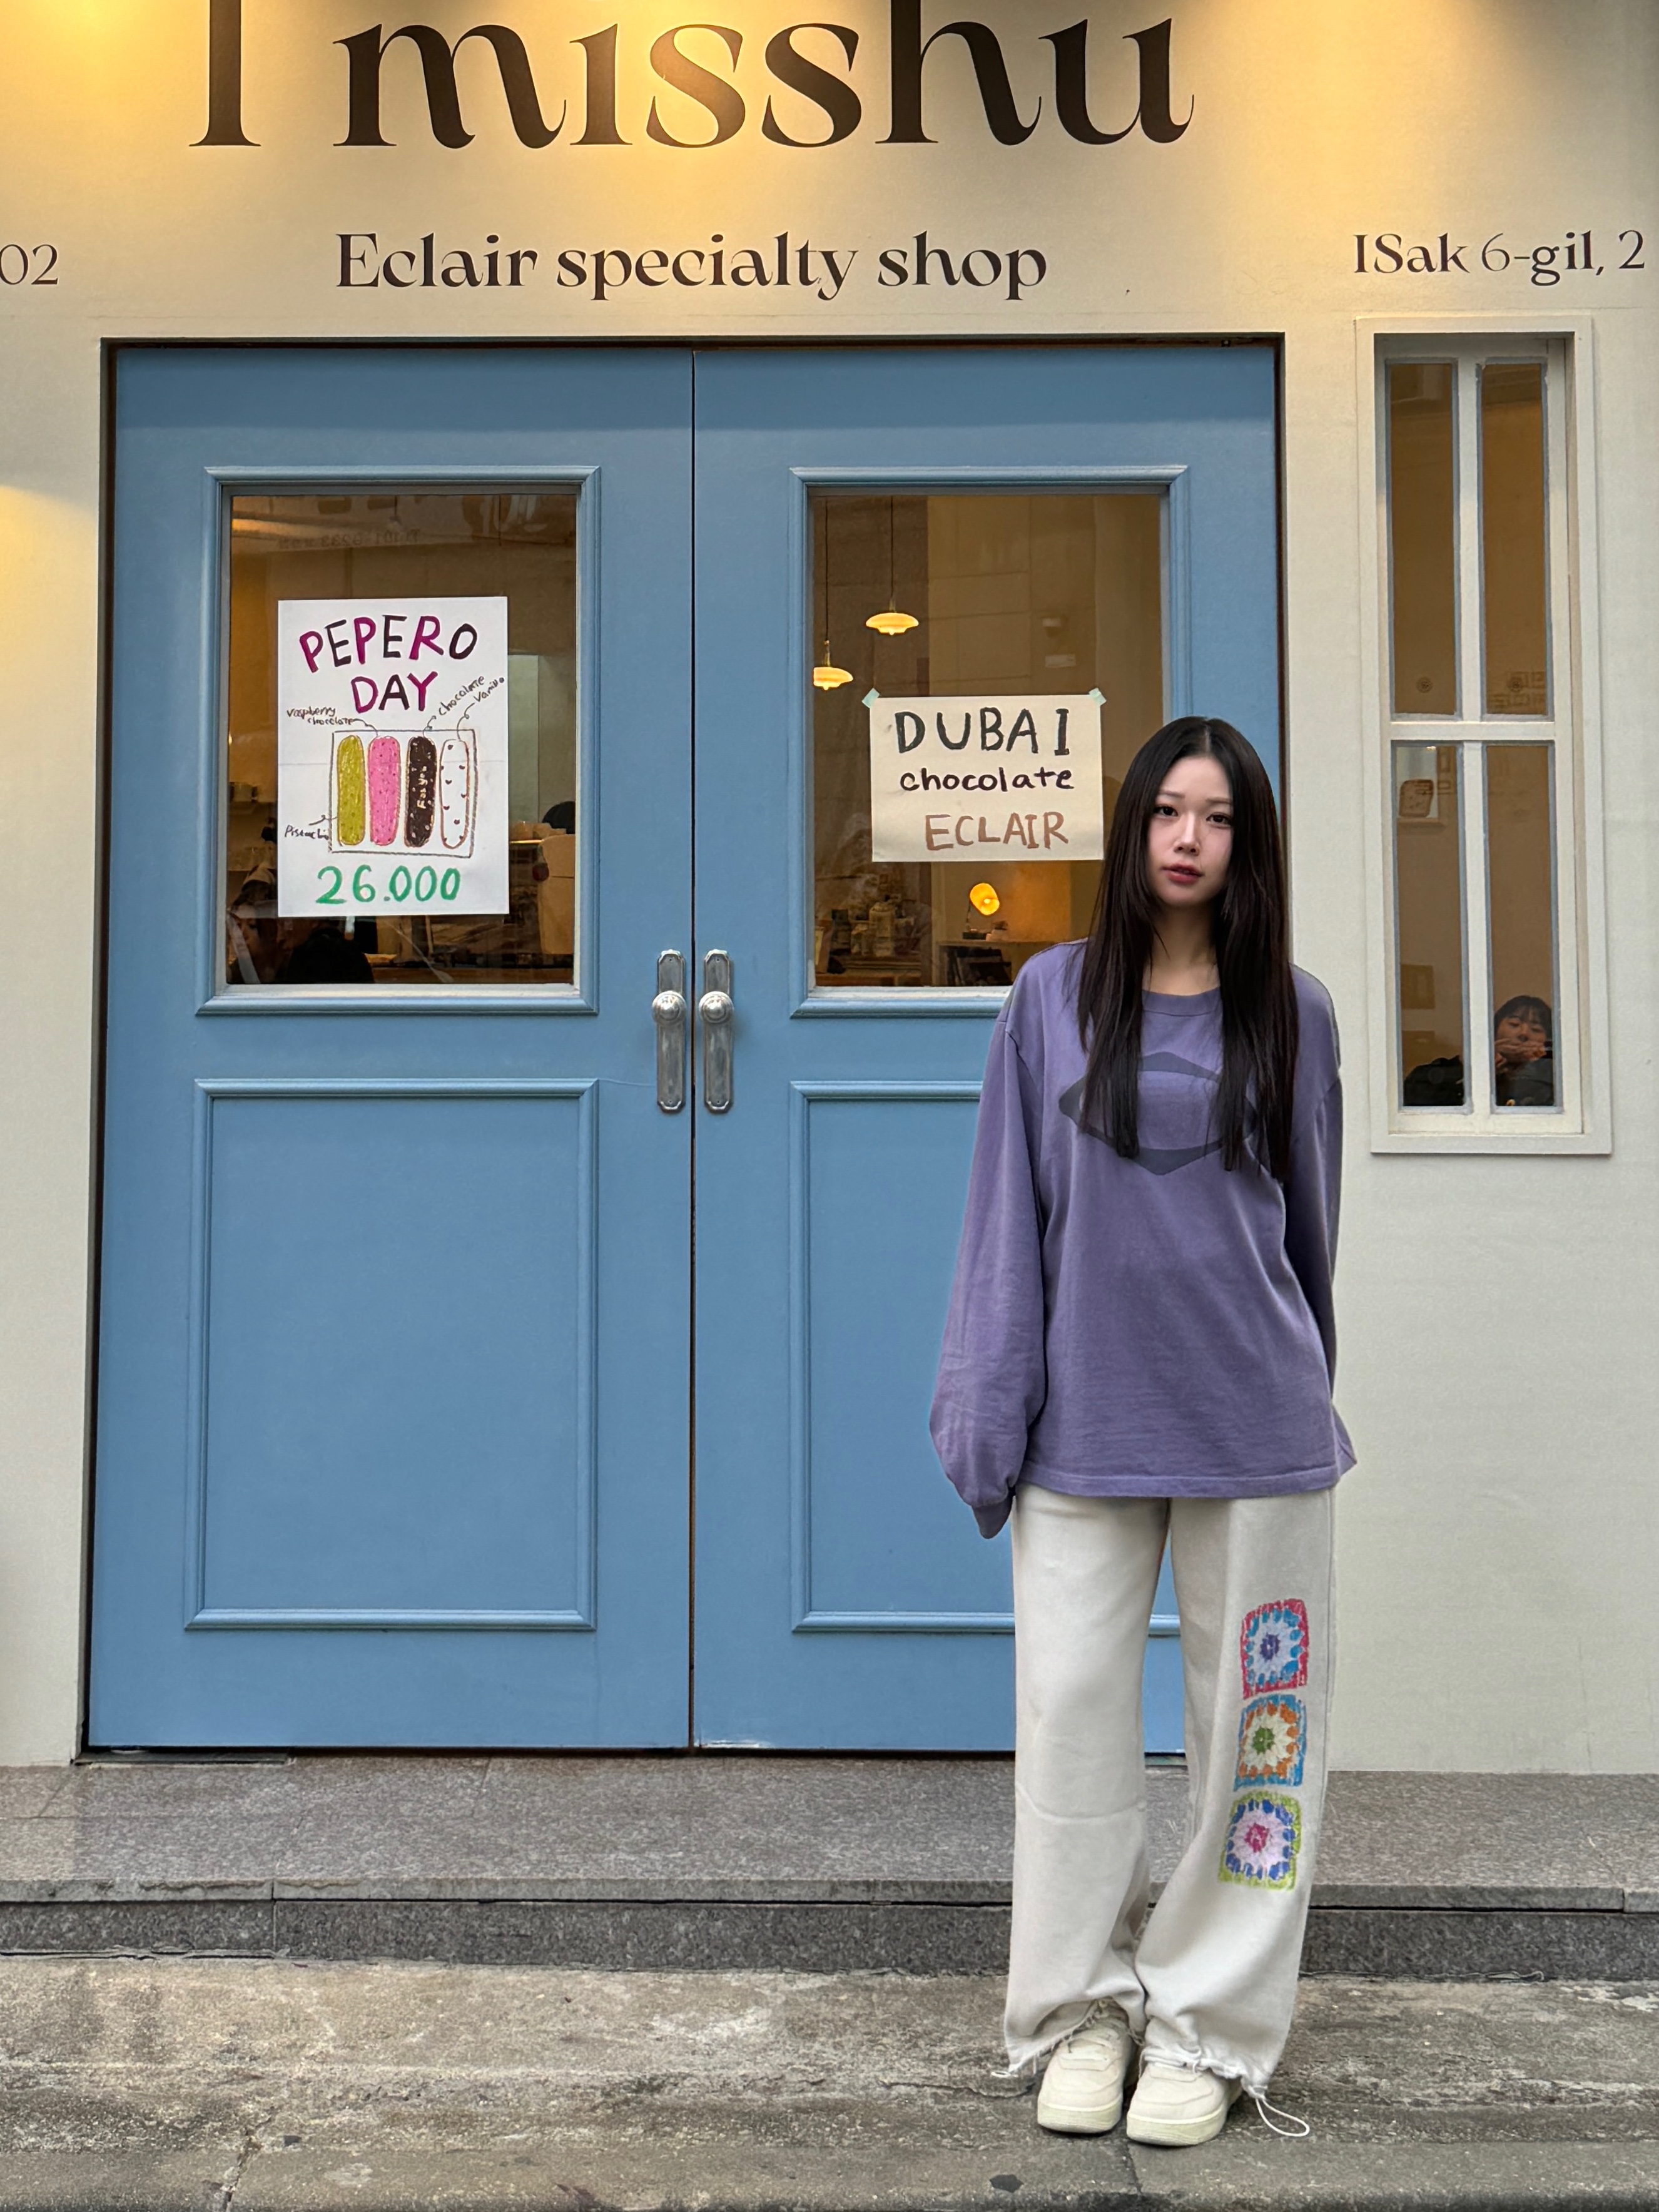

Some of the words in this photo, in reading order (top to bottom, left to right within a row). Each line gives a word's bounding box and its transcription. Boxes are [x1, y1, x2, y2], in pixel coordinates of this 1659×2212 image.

[0, 244, 58, 285] 02
[336, 232, 538, 288] Eclair
[557, 231, 858, 301] specialty
[878, 230, 1047, 300] shop
[1481, 230, 1604, 287] 6-gil,
[1618, 230, 1645, 269] 2
[300, 614, 477, 673] PEPERO
[351, 671, 439, 713] DAY
[895, 706, 1070, 756] DUBAI
[900, 767, 1074, 792] chocolate
[925, 812, 1069, 851] ECLAIR
[315, 864, 460, 904] 26.000
